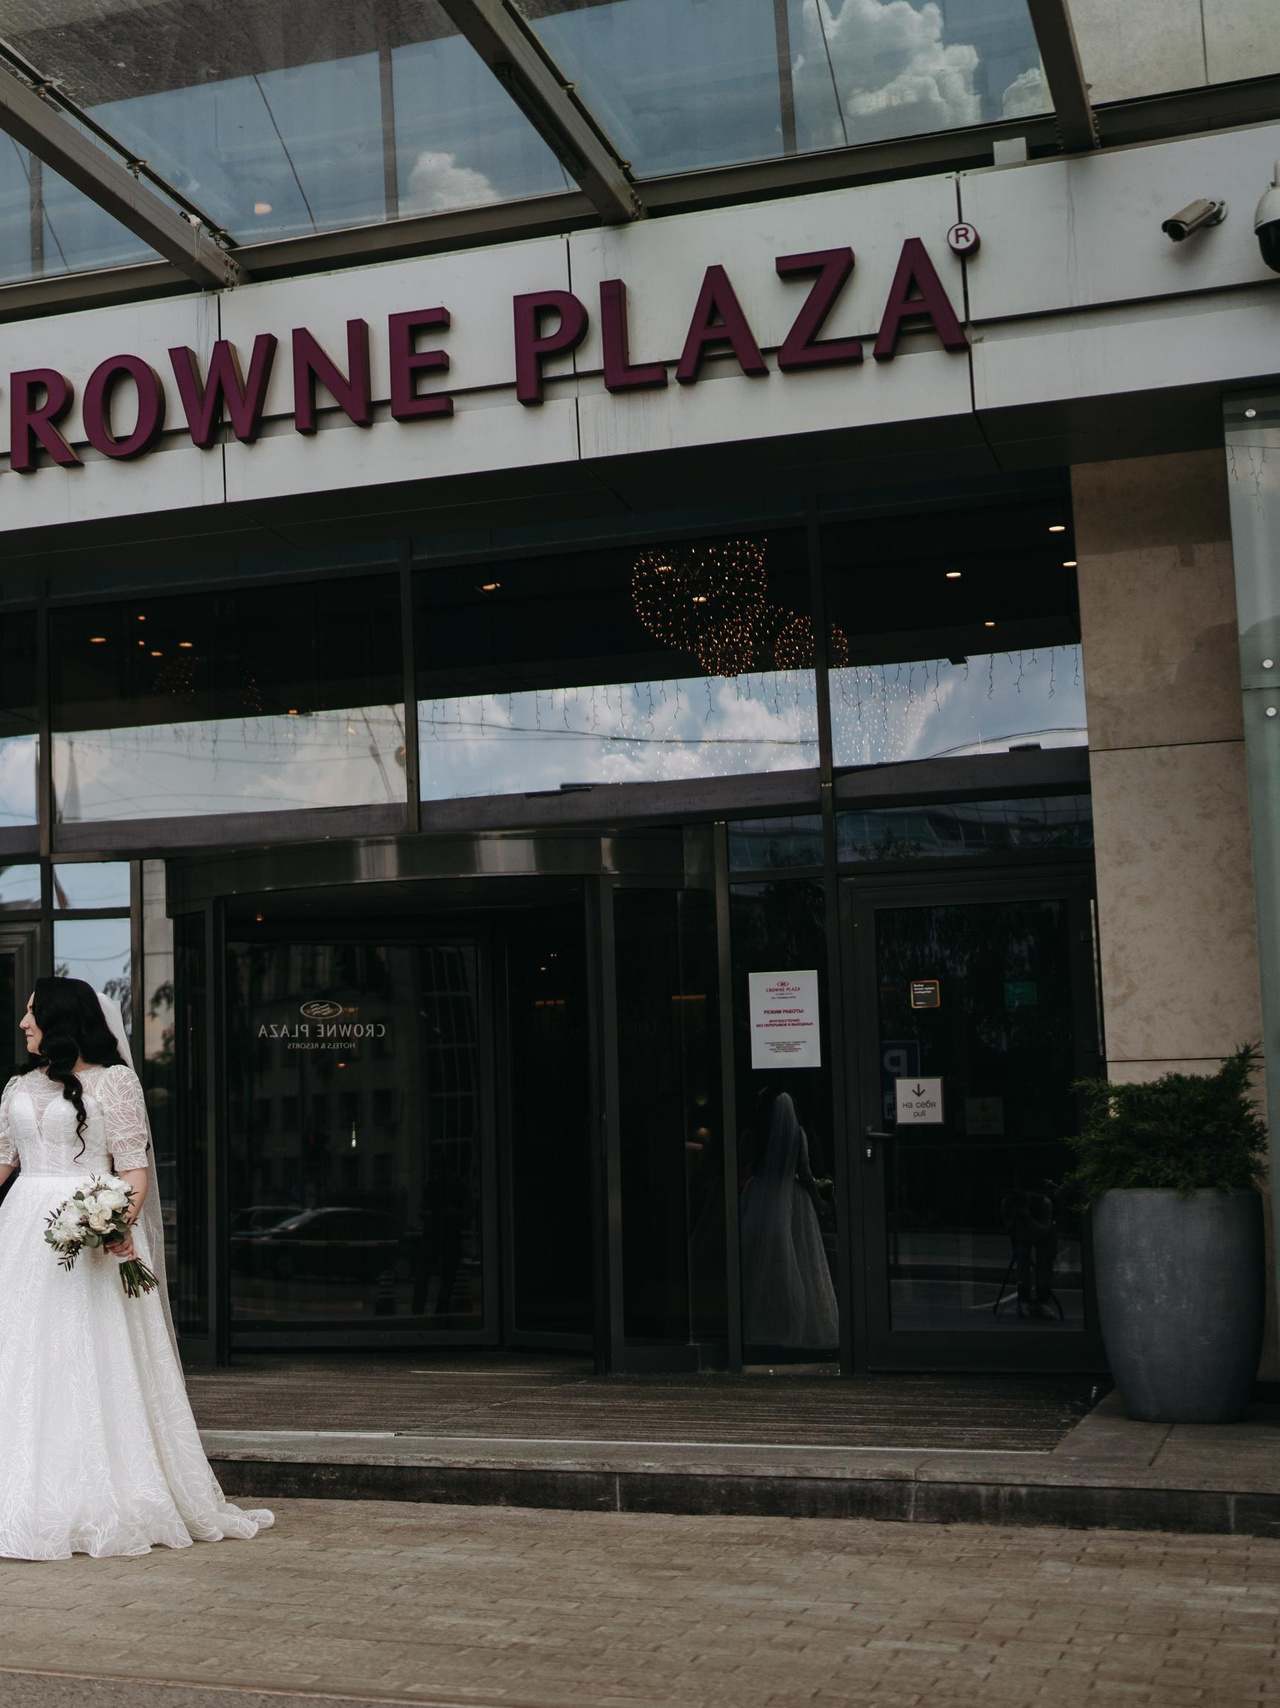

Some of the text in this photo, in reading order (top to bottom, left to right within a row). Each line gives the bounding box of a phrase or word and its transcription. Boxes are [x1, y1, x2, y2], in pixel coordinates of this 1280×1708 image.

[902, 1099, 937, 1109] на себя
[913, 1109, 926, 1118] pull
